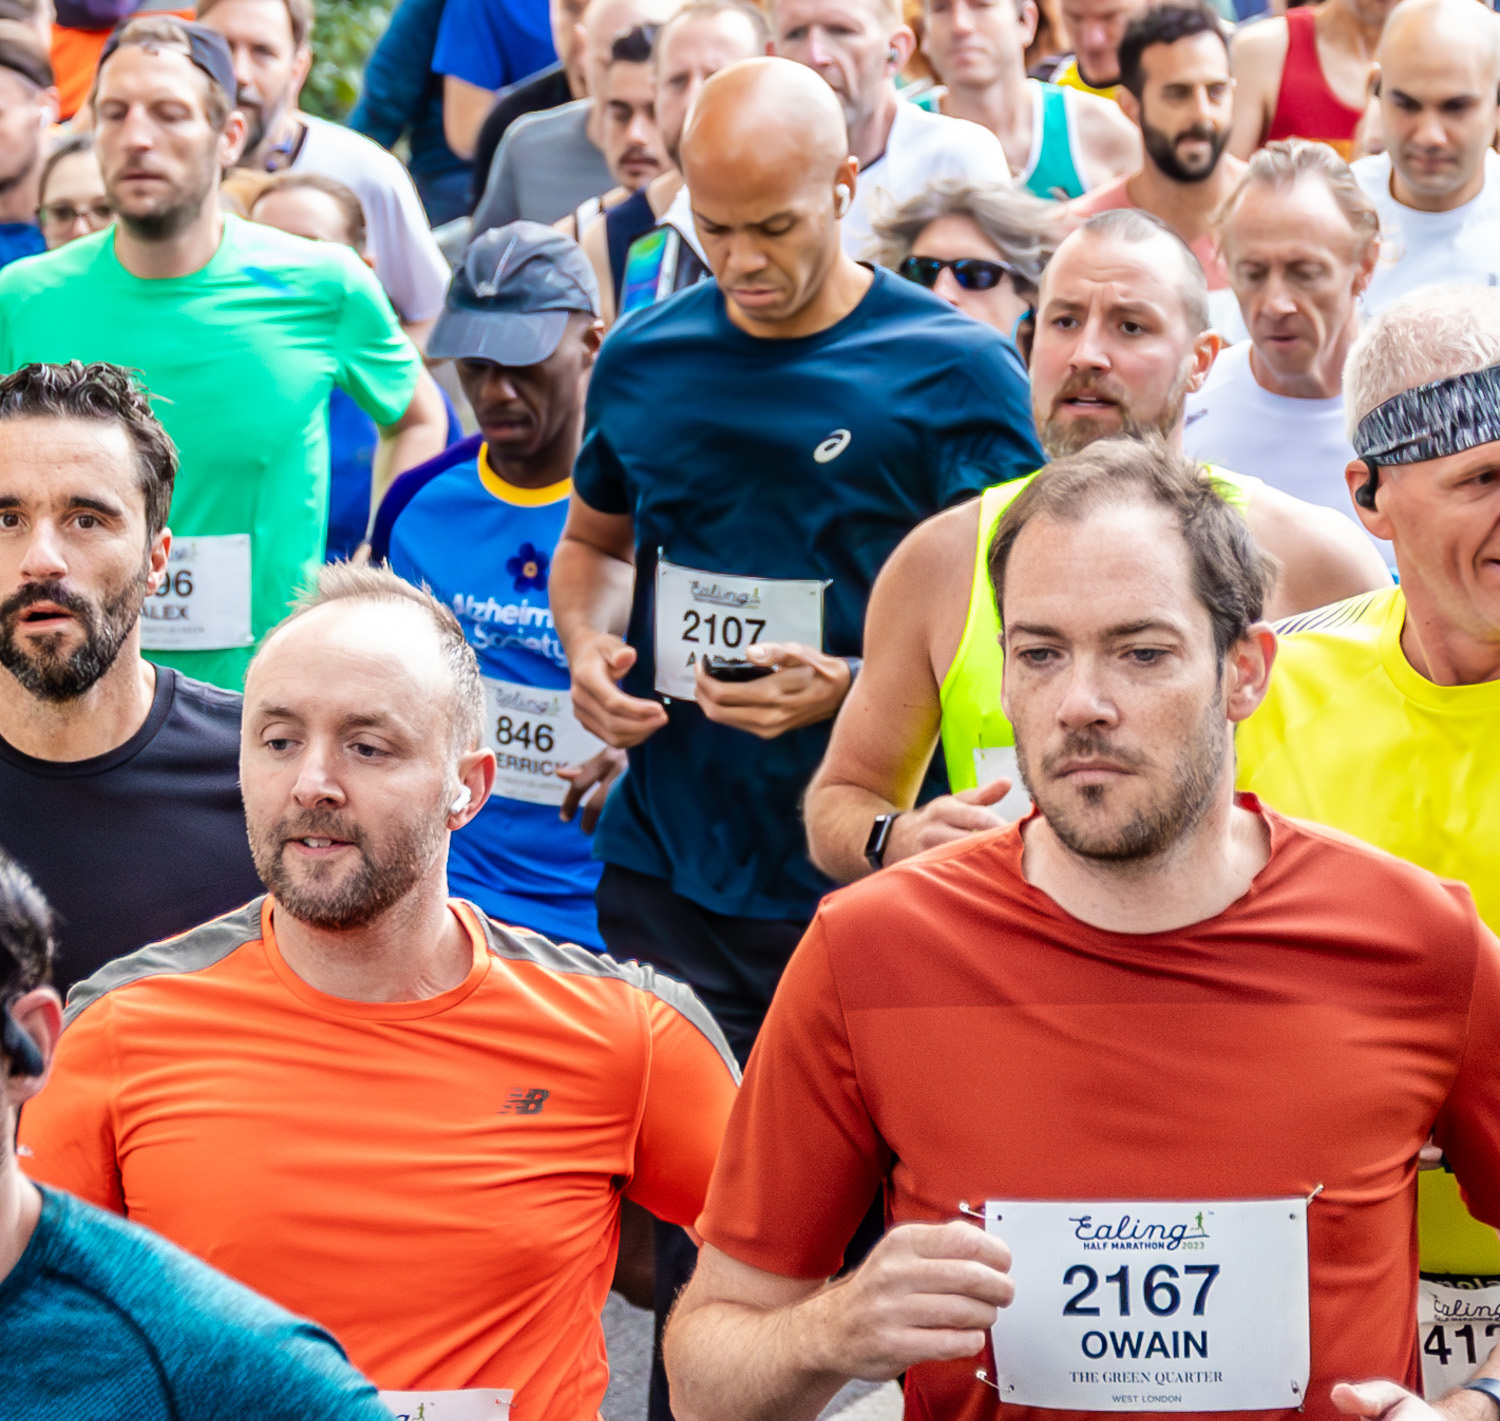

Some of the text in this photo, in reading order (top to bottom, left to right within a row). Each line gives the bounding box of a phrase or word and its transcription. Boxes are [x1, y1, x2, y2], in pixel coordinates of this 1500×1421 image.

[682, 610, 766, 648] 2107
[496, 715, 554, 753] 846
[1068, 1215, 1206, 1250] Ealing
[1083, 1242, 1205, 1250] HALF MARATHON 2023
[1062, 1263, 1220, 1317] 2167
[1081, 1330, 1208, 1359] OWAIN
[1069, 1371, 1223, 1386] THE GREEN QUARTER
[1111, 1395, 1182, 1403] WEST LONDON
